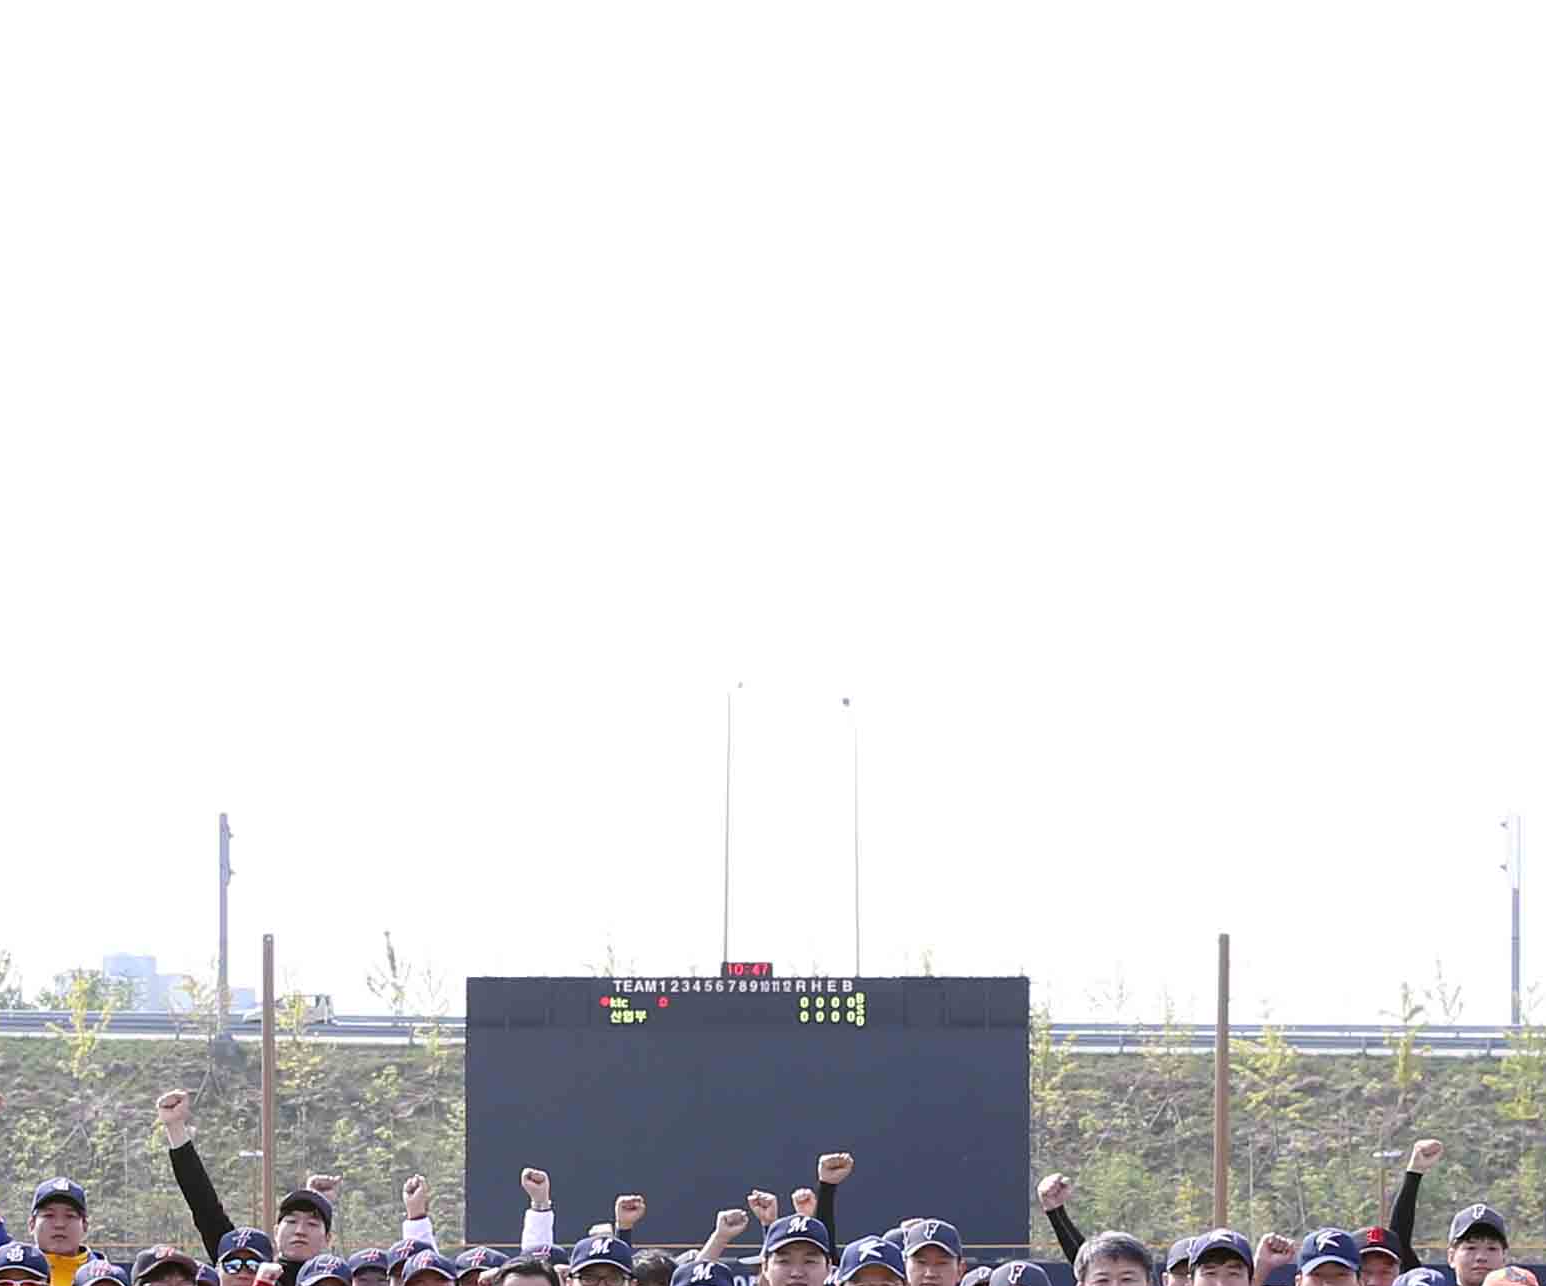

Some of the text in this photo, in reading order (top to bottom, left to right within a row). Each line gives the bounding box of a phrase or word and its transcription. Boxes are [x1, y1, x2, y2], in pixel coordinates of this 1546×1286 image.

[727, 963, 769, 977] 10:47
[613, 980, 853, 993] TEAM 1 2 3 4 5 6 7 8 9 10 11 12 R H E B
[799, 996, 809, 1008] 0
[815, 996, 825, 1008] 0
[831, 996, 840, 1008] 0
[846, 996, 856, 1008] 0
[610, 1010, 856, 1024] 산업부 0 0 0 0
[787, 1215, 809, 1233] M
[589, 1238, 612, 1257] M
[691, 1263, 715, 1283] M
